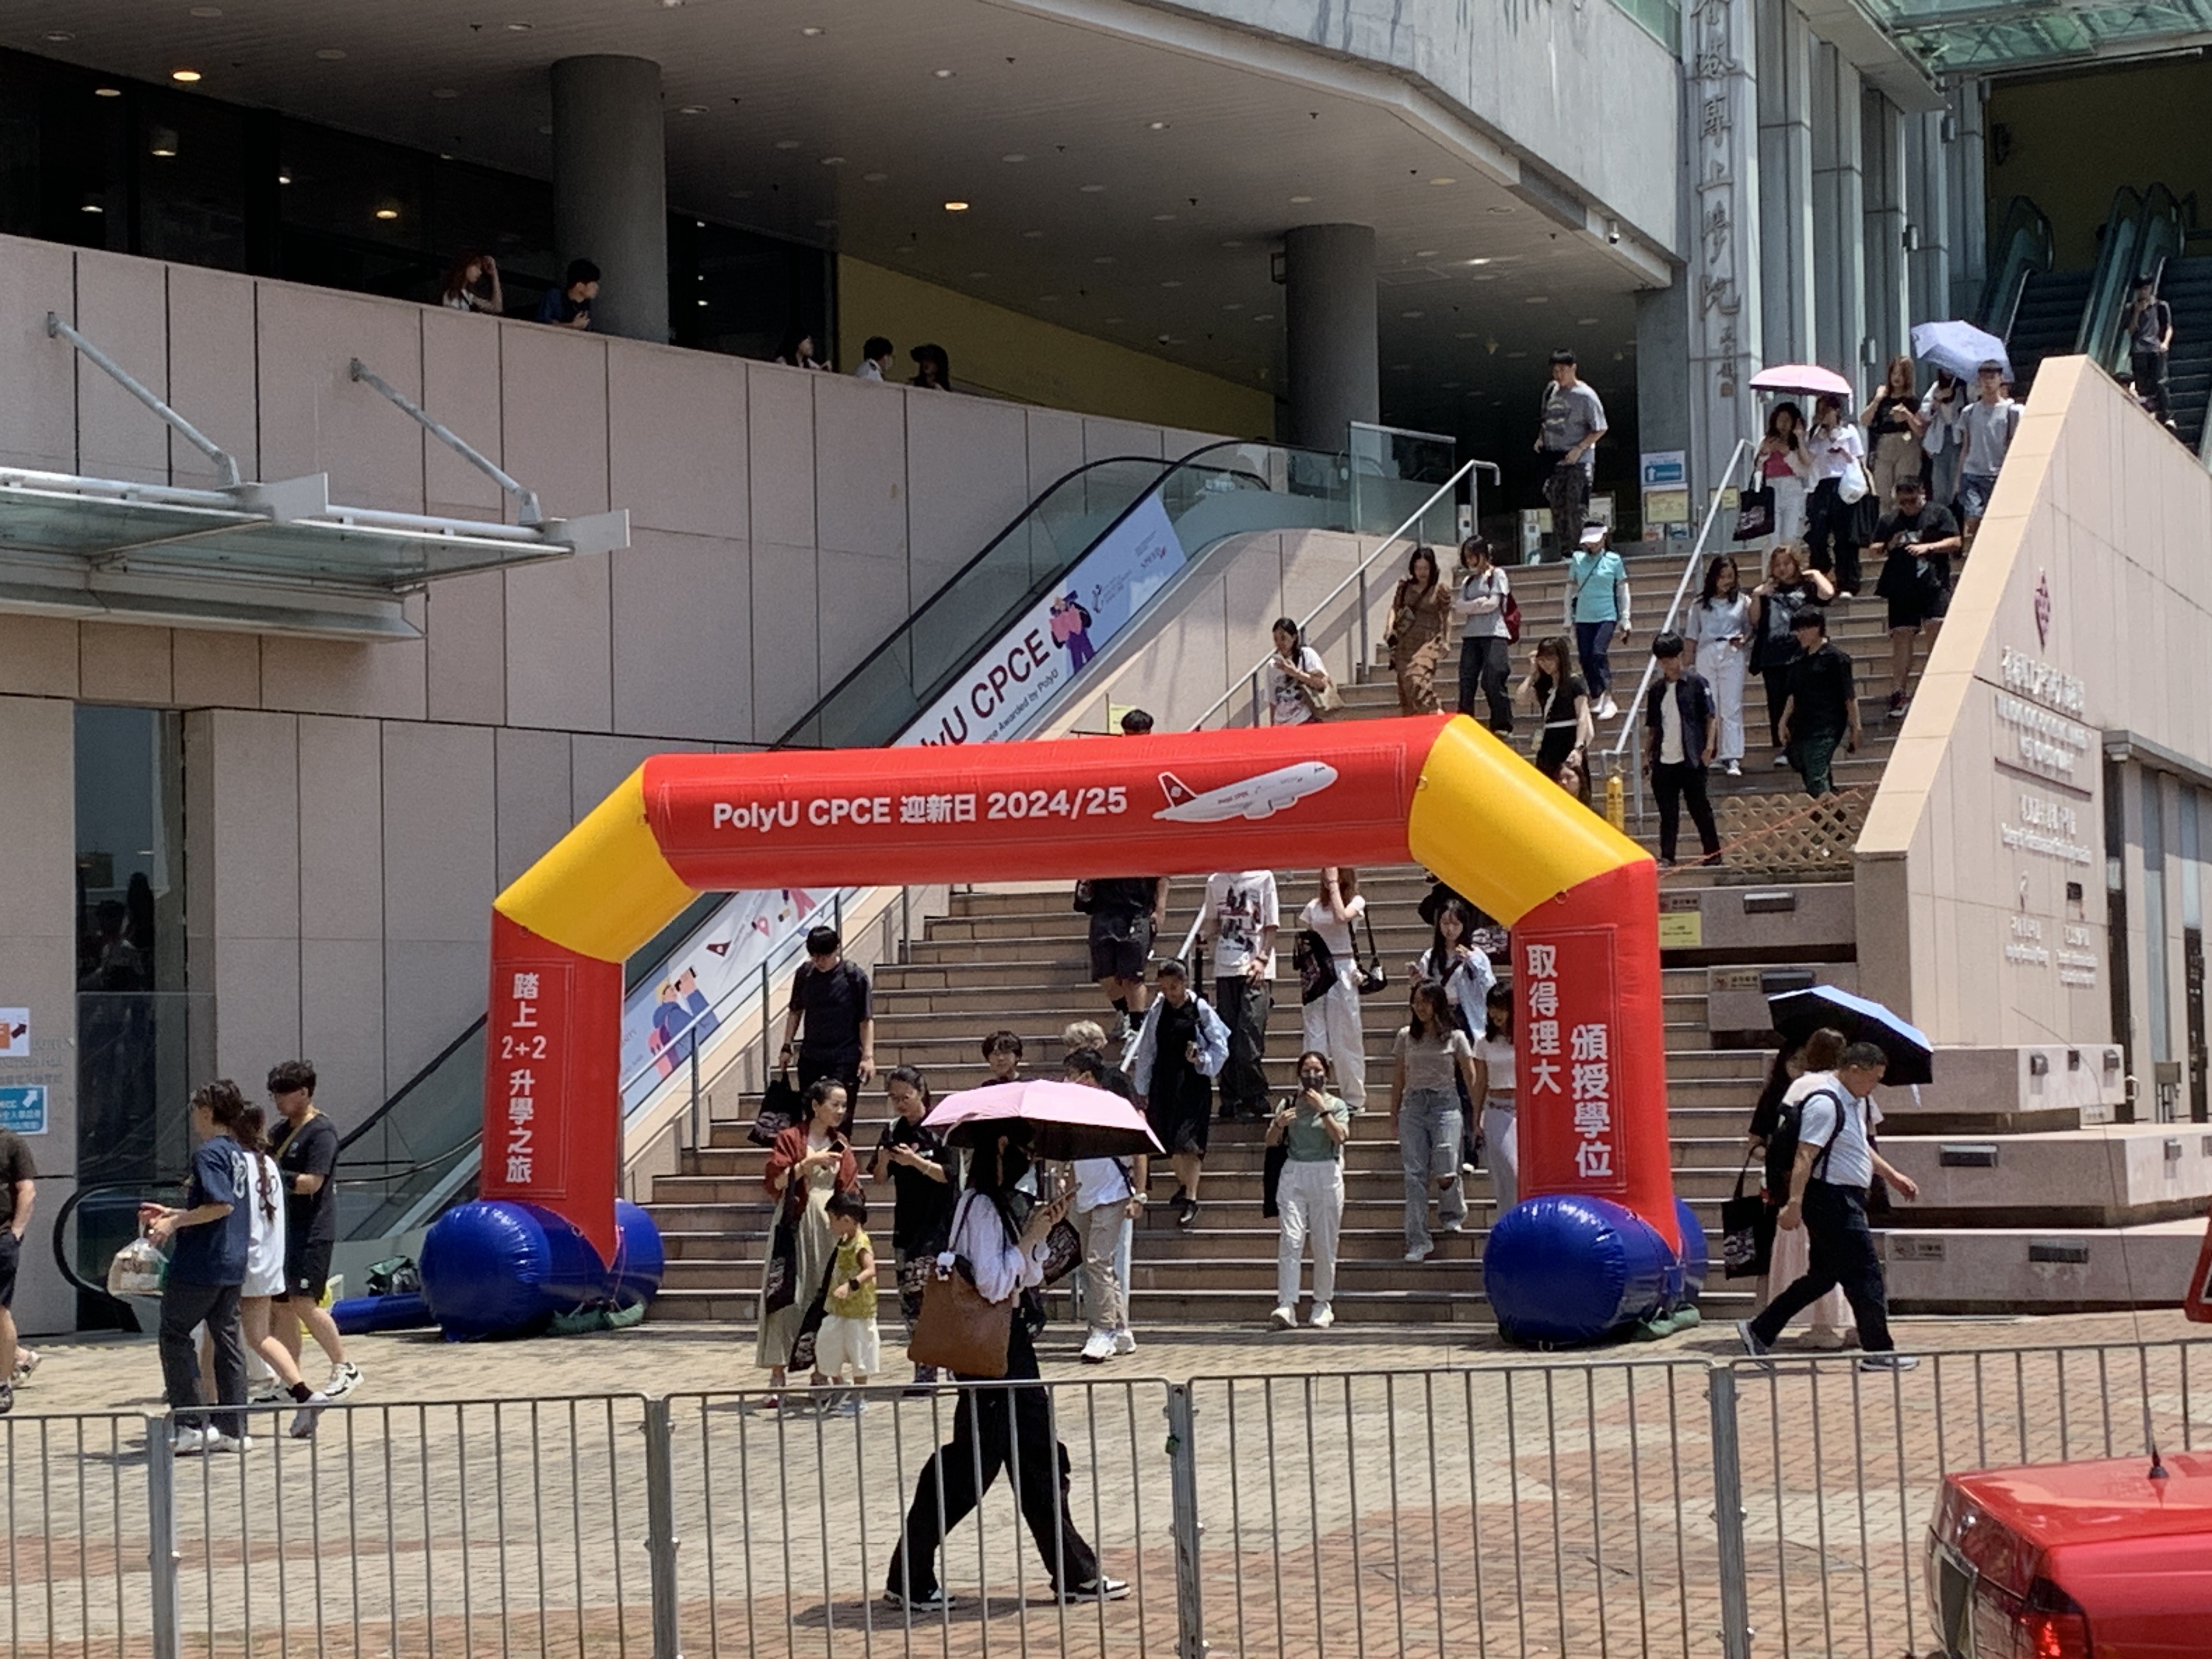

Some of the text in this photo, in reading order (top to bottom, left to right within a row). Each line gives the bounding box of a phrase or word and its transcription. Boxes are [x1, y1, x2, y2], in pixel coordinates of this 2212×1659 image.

[971, 628, 1051, 719] CPCE
[714, 786, 1127, 832] PolyU CPCE 迎新日 2024/25
[501, 972, 546, 1183] 踏上 2+2 升學之旅
[1526, 943, 1561, 1095] 取得理大
[1570, 1023, 1613, 1178] 頒授學位
